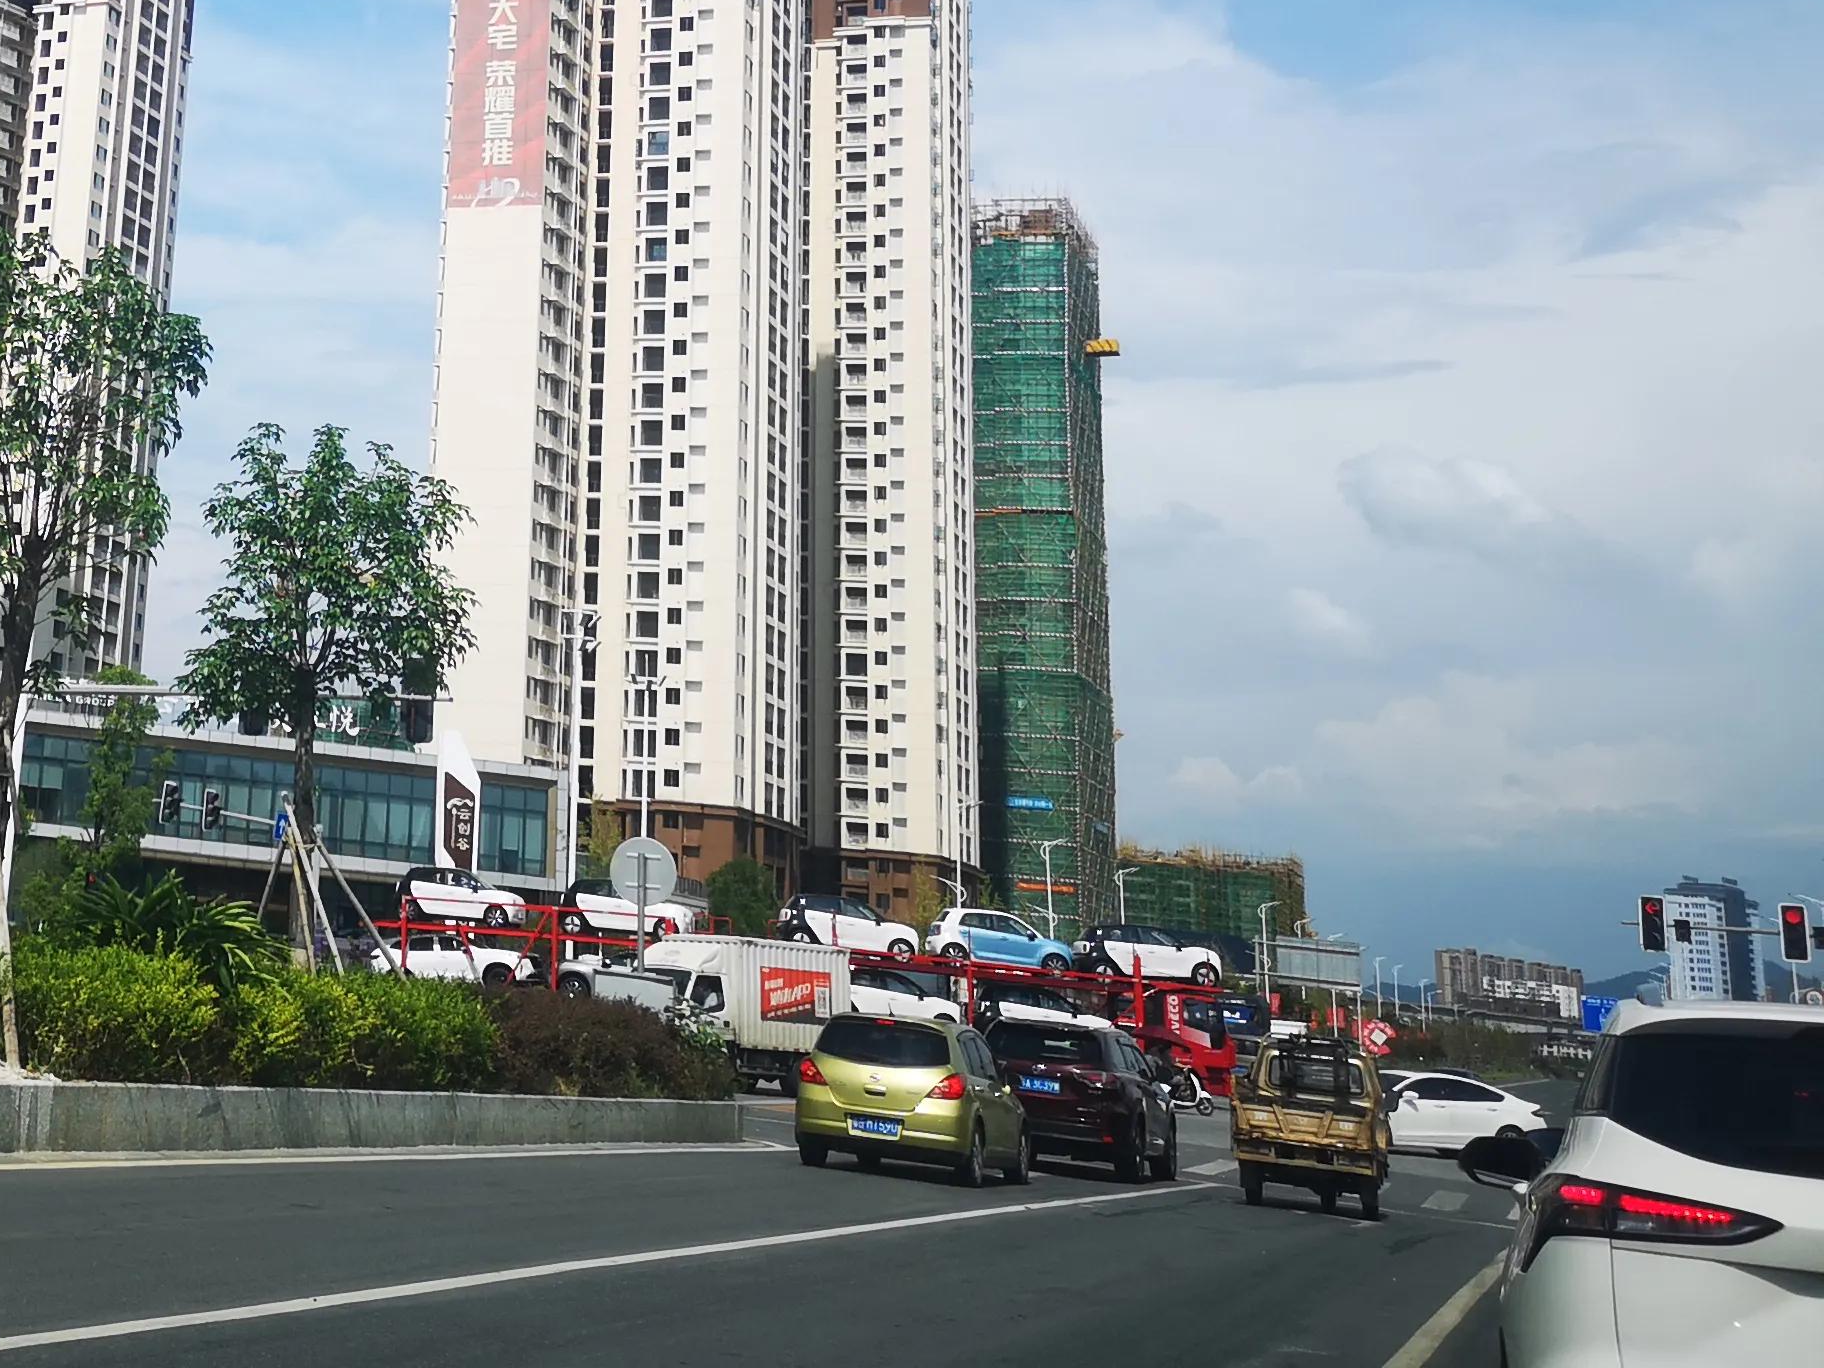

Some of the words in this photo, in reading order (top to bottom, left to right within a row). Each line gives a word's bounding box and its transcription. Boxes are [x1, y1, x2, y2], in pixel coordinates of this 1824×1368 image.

[482, 60, 517, 166] 荣耀首推
[456, 808, 473, 851] 云创谷
[1167, 994, 1181, 1036] IVECO
